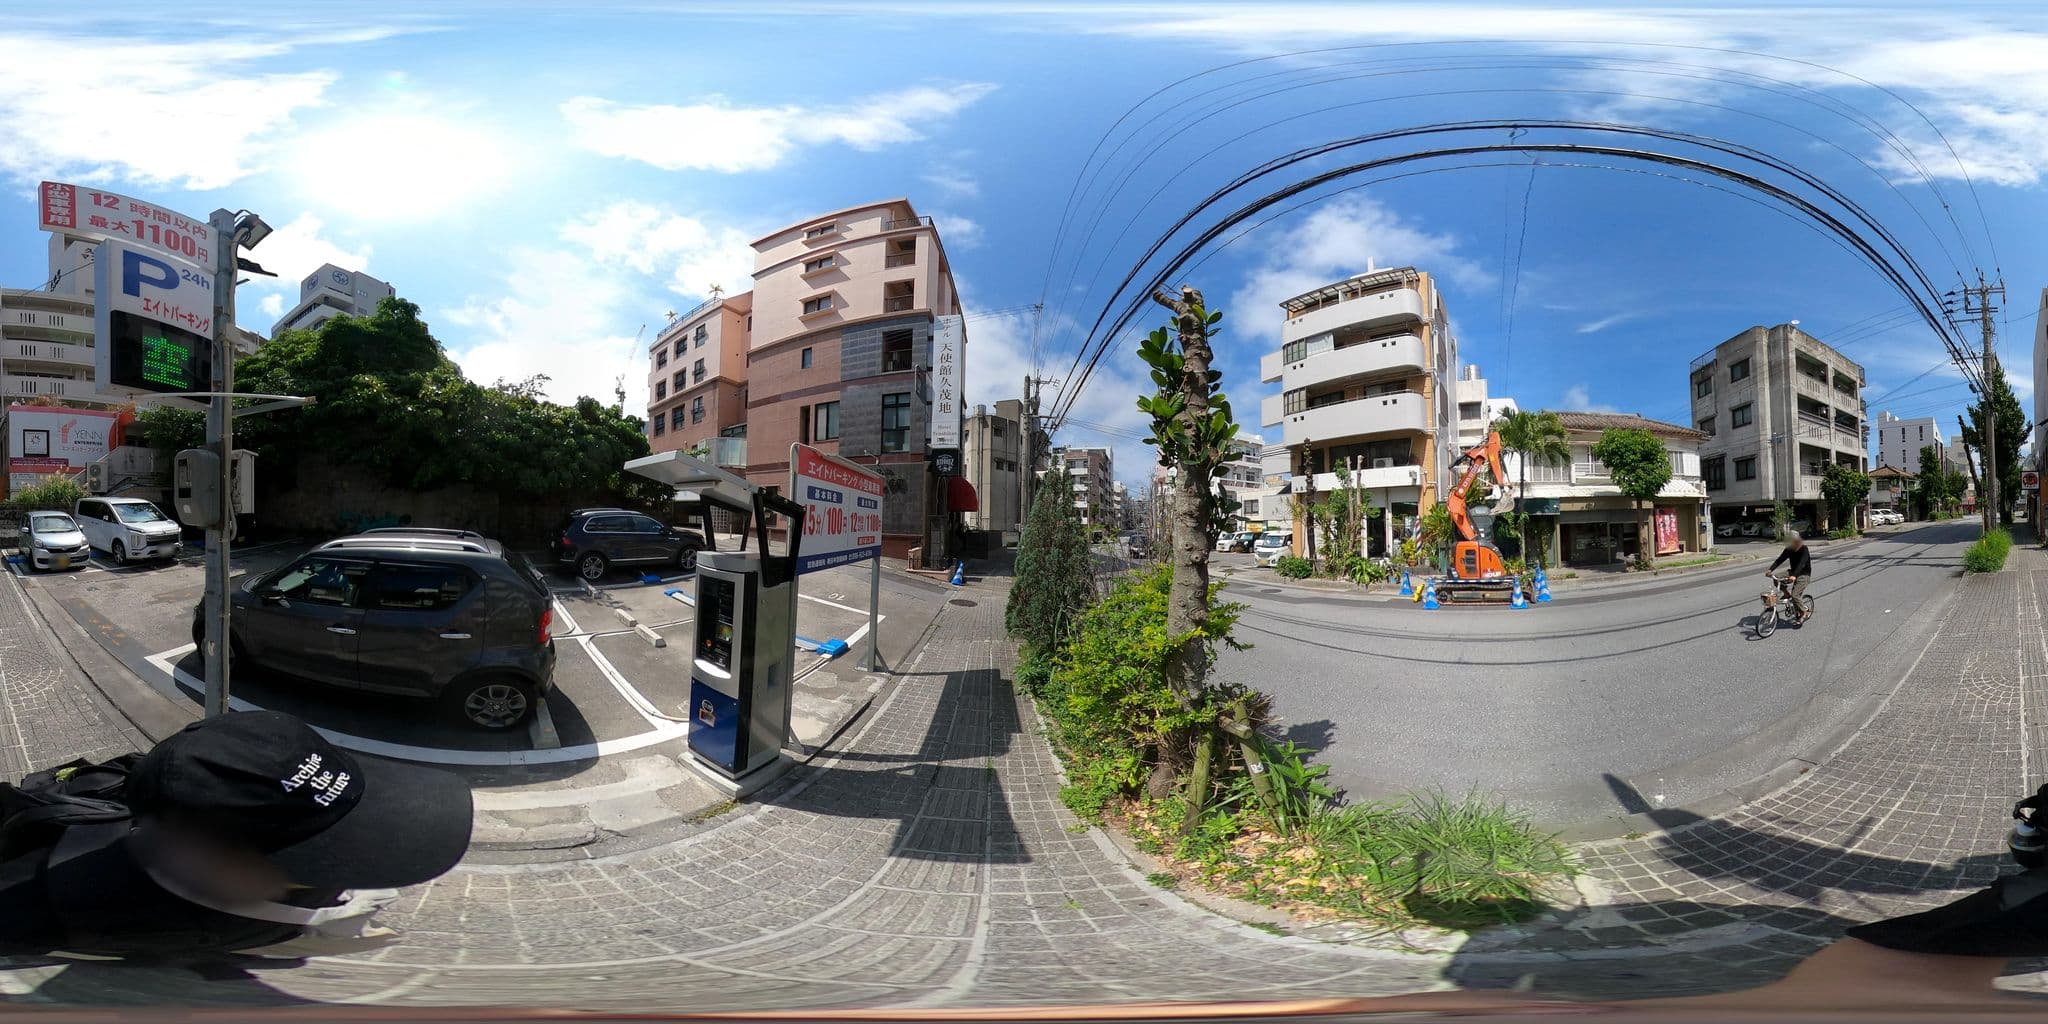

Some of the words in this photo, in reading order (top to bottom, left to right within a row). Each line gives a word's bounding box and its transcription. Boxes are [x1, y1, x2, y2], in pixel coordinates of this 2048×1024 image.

[88, 214, 208, 264] 最大1100円
[123, 250, 180, 297] P
[181, 269, 210, 291] 24h
[143, 297, 210, 333] エイトパーキング
[808, 461, 859, 487] エイトパーキング
[310, 770, 334, 791] the
[313, 771, 351, 807] future
